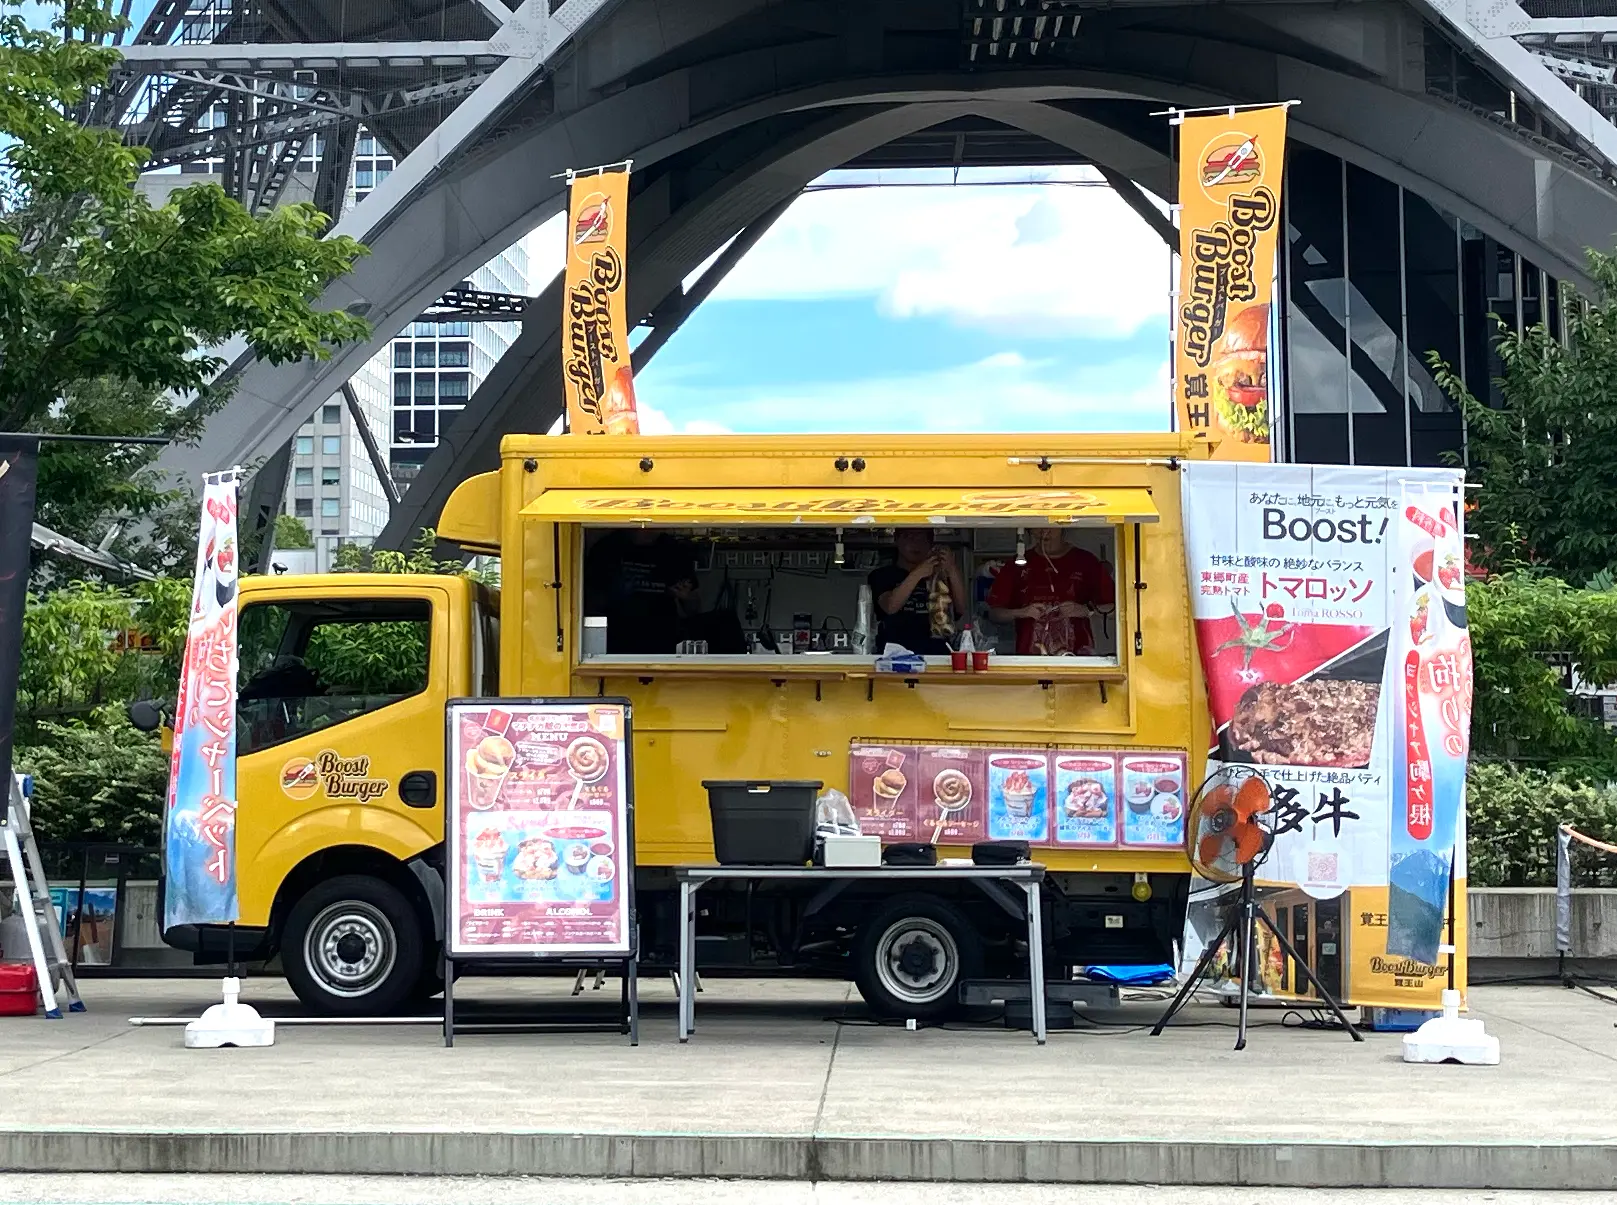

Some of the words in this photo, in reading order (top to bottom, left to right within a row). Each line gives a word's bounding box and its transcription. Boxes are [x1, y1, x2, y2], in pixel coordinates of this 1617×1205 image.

[1229, 187, 1277, 302] Boost
[591, 246, 623, 363] Boost
[1182, 223, 1231, 367] Burger
[567, 280, 603, 424] Burger
[1183, 373, 1211, 438] 覚王
[1263, 508, 1389, 544] Boost!
[1200, 585, 1250, 597] 完熟トマト
[1201, 571, 1249, 584] 東郷町産
[1262, 572, 1373, 602] トマロッソ
[318, 751, 369, 775] Boost
[325, 772, 389, 803] Burger
